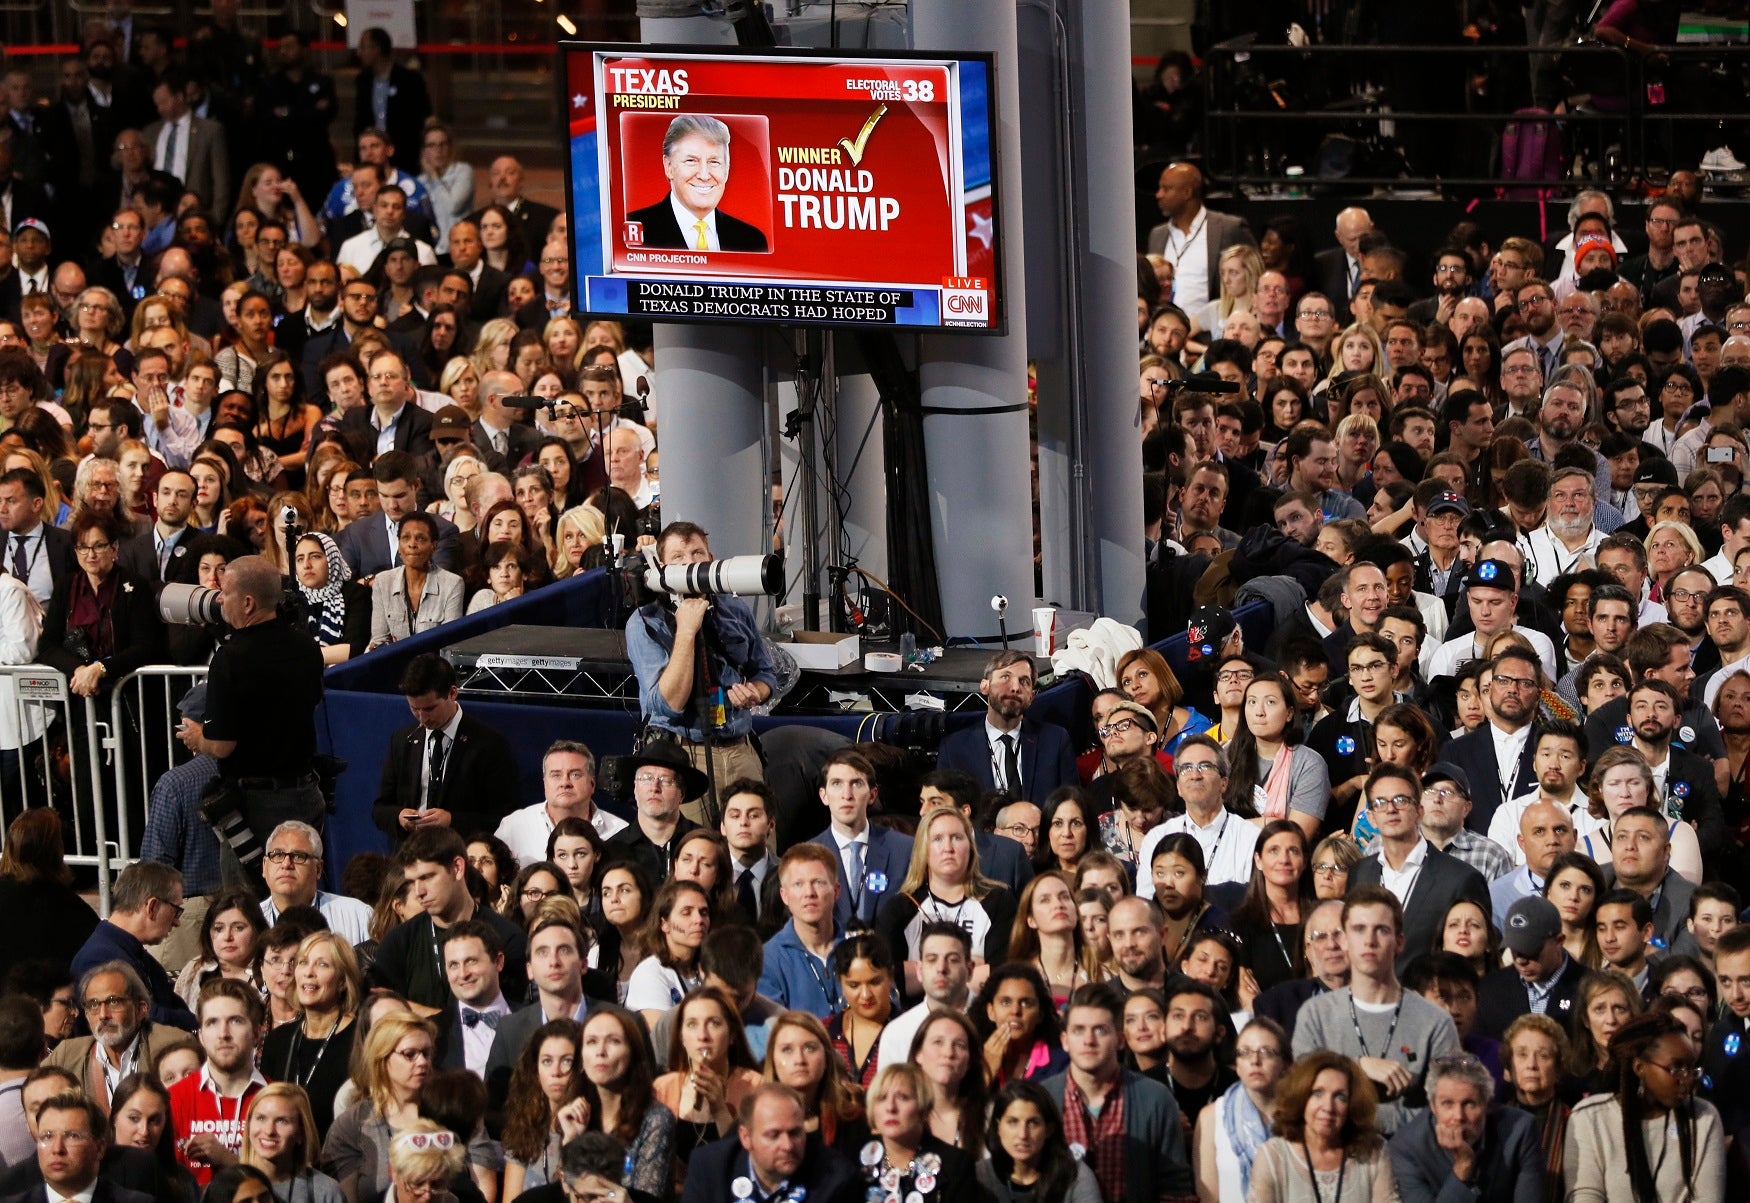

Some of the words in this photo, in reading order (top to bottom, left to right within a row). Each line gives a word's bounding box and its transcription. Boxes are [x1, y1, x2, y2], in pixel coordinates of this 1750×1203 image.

[609, 68, 689, 96] TEXAS
[846, 79, 901, 90] ELECTORAL
[902, 80, 935, 102] 38
[613, 95, 681, 109] PRESIDENT
[870, 90, 901, 100] VOTES
[777, 147, 841, 165] WINNER
[778, 167, 873, 193] DONALD
[777, 194, 900, 231] TRUMP
[628, 224, 639, 241] R
[626, 252, 646, 262] CNN
[649, 253, 707, 265] PROJECTION
[948, 279, 982, 289] LIVE
[640, 283, 704, 297] DONALD
[707, 285, 763, 300] TRUMP
[768, 288, 786, 301] IN
[788, 288, 821, 302] THE
[826, 290, 875, 304] STATE
[879, 292, 901, 305] OF
[639, 299, 689, 313] TEXAS
[692, 301, 790, 317] DEMOCRATS
[794, 305, 828, 318] HAD
[832, 306, 887, 320] HOPED
[948, 295, 982, 314] CNN
